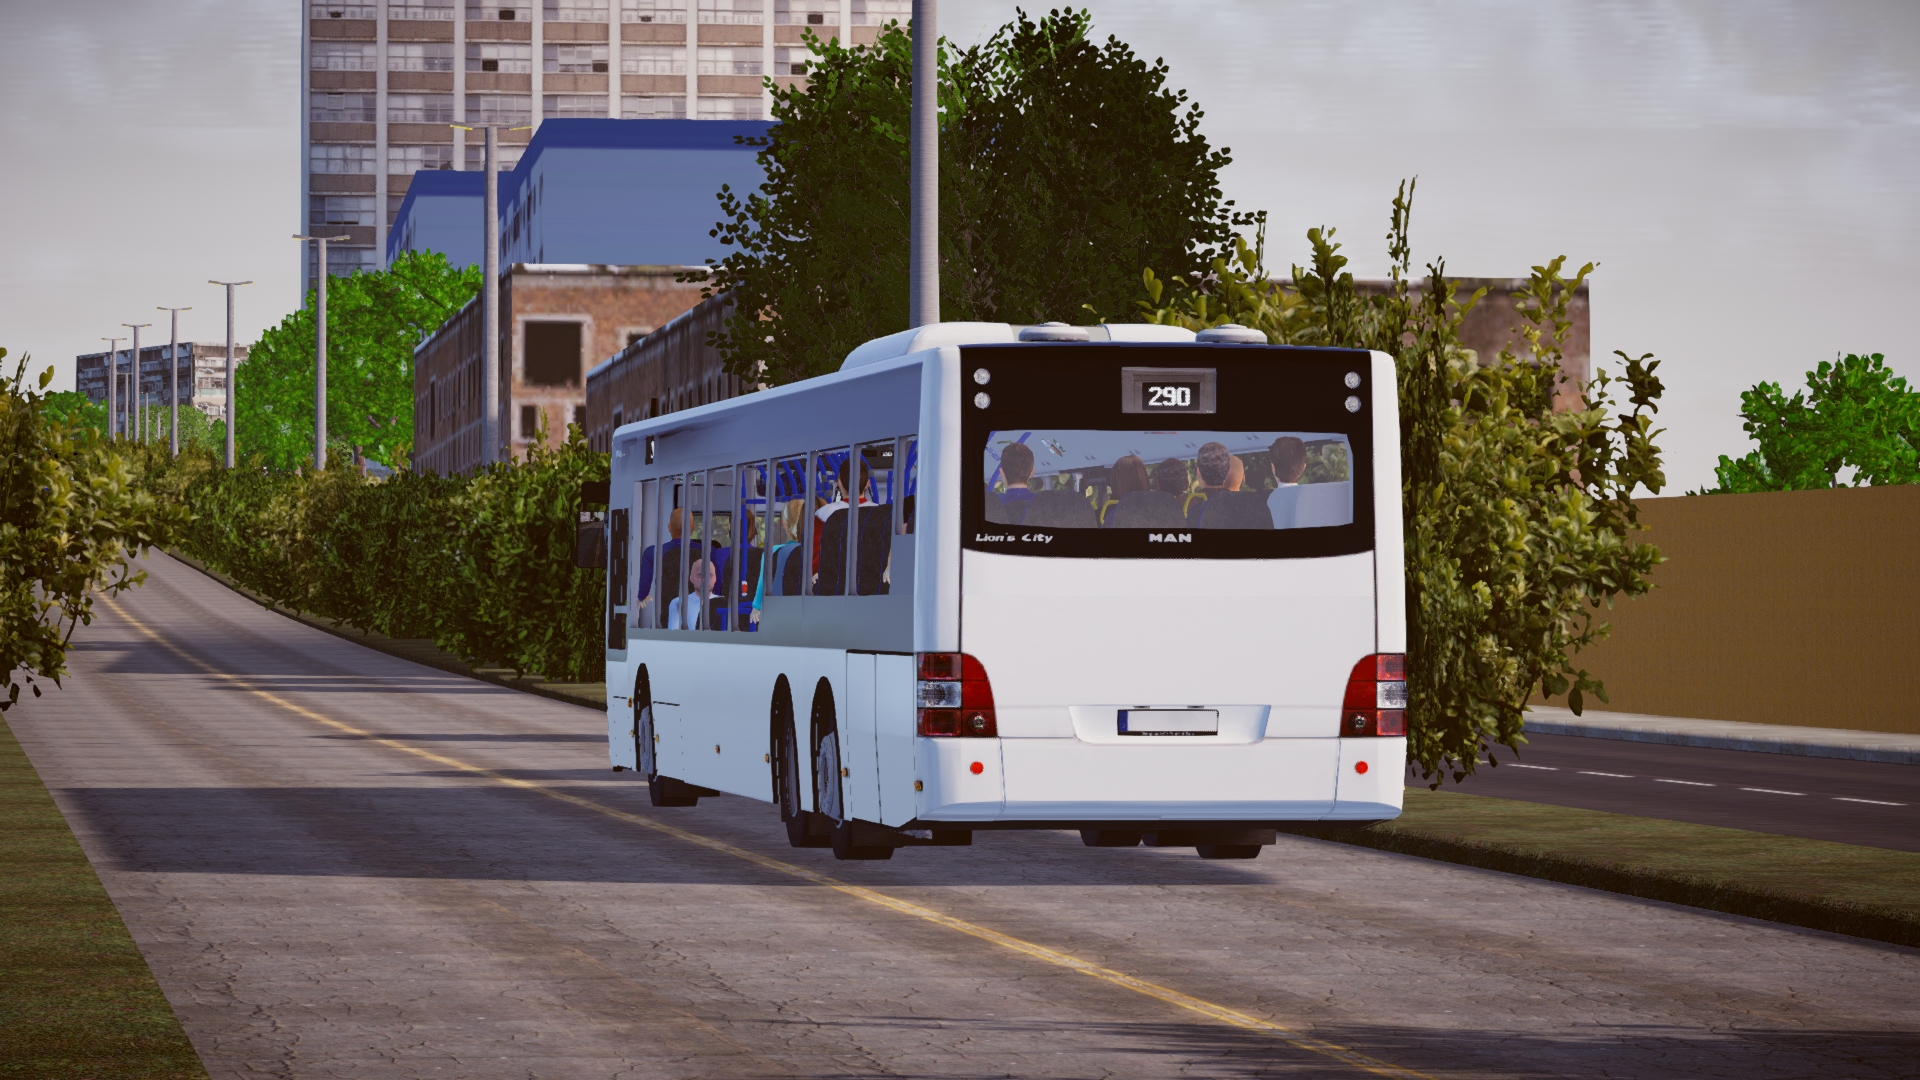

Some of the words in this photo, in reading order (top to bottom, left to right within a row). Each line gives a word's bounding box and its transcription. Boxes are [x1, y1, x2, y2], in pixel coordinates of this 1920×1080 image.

[1148, 386, 1191, 406] 290
[975, 532, 1016, 542] Lion's
[1021, 533, 1054, 544] City
[1148, 533, 1192, 543] MAN
